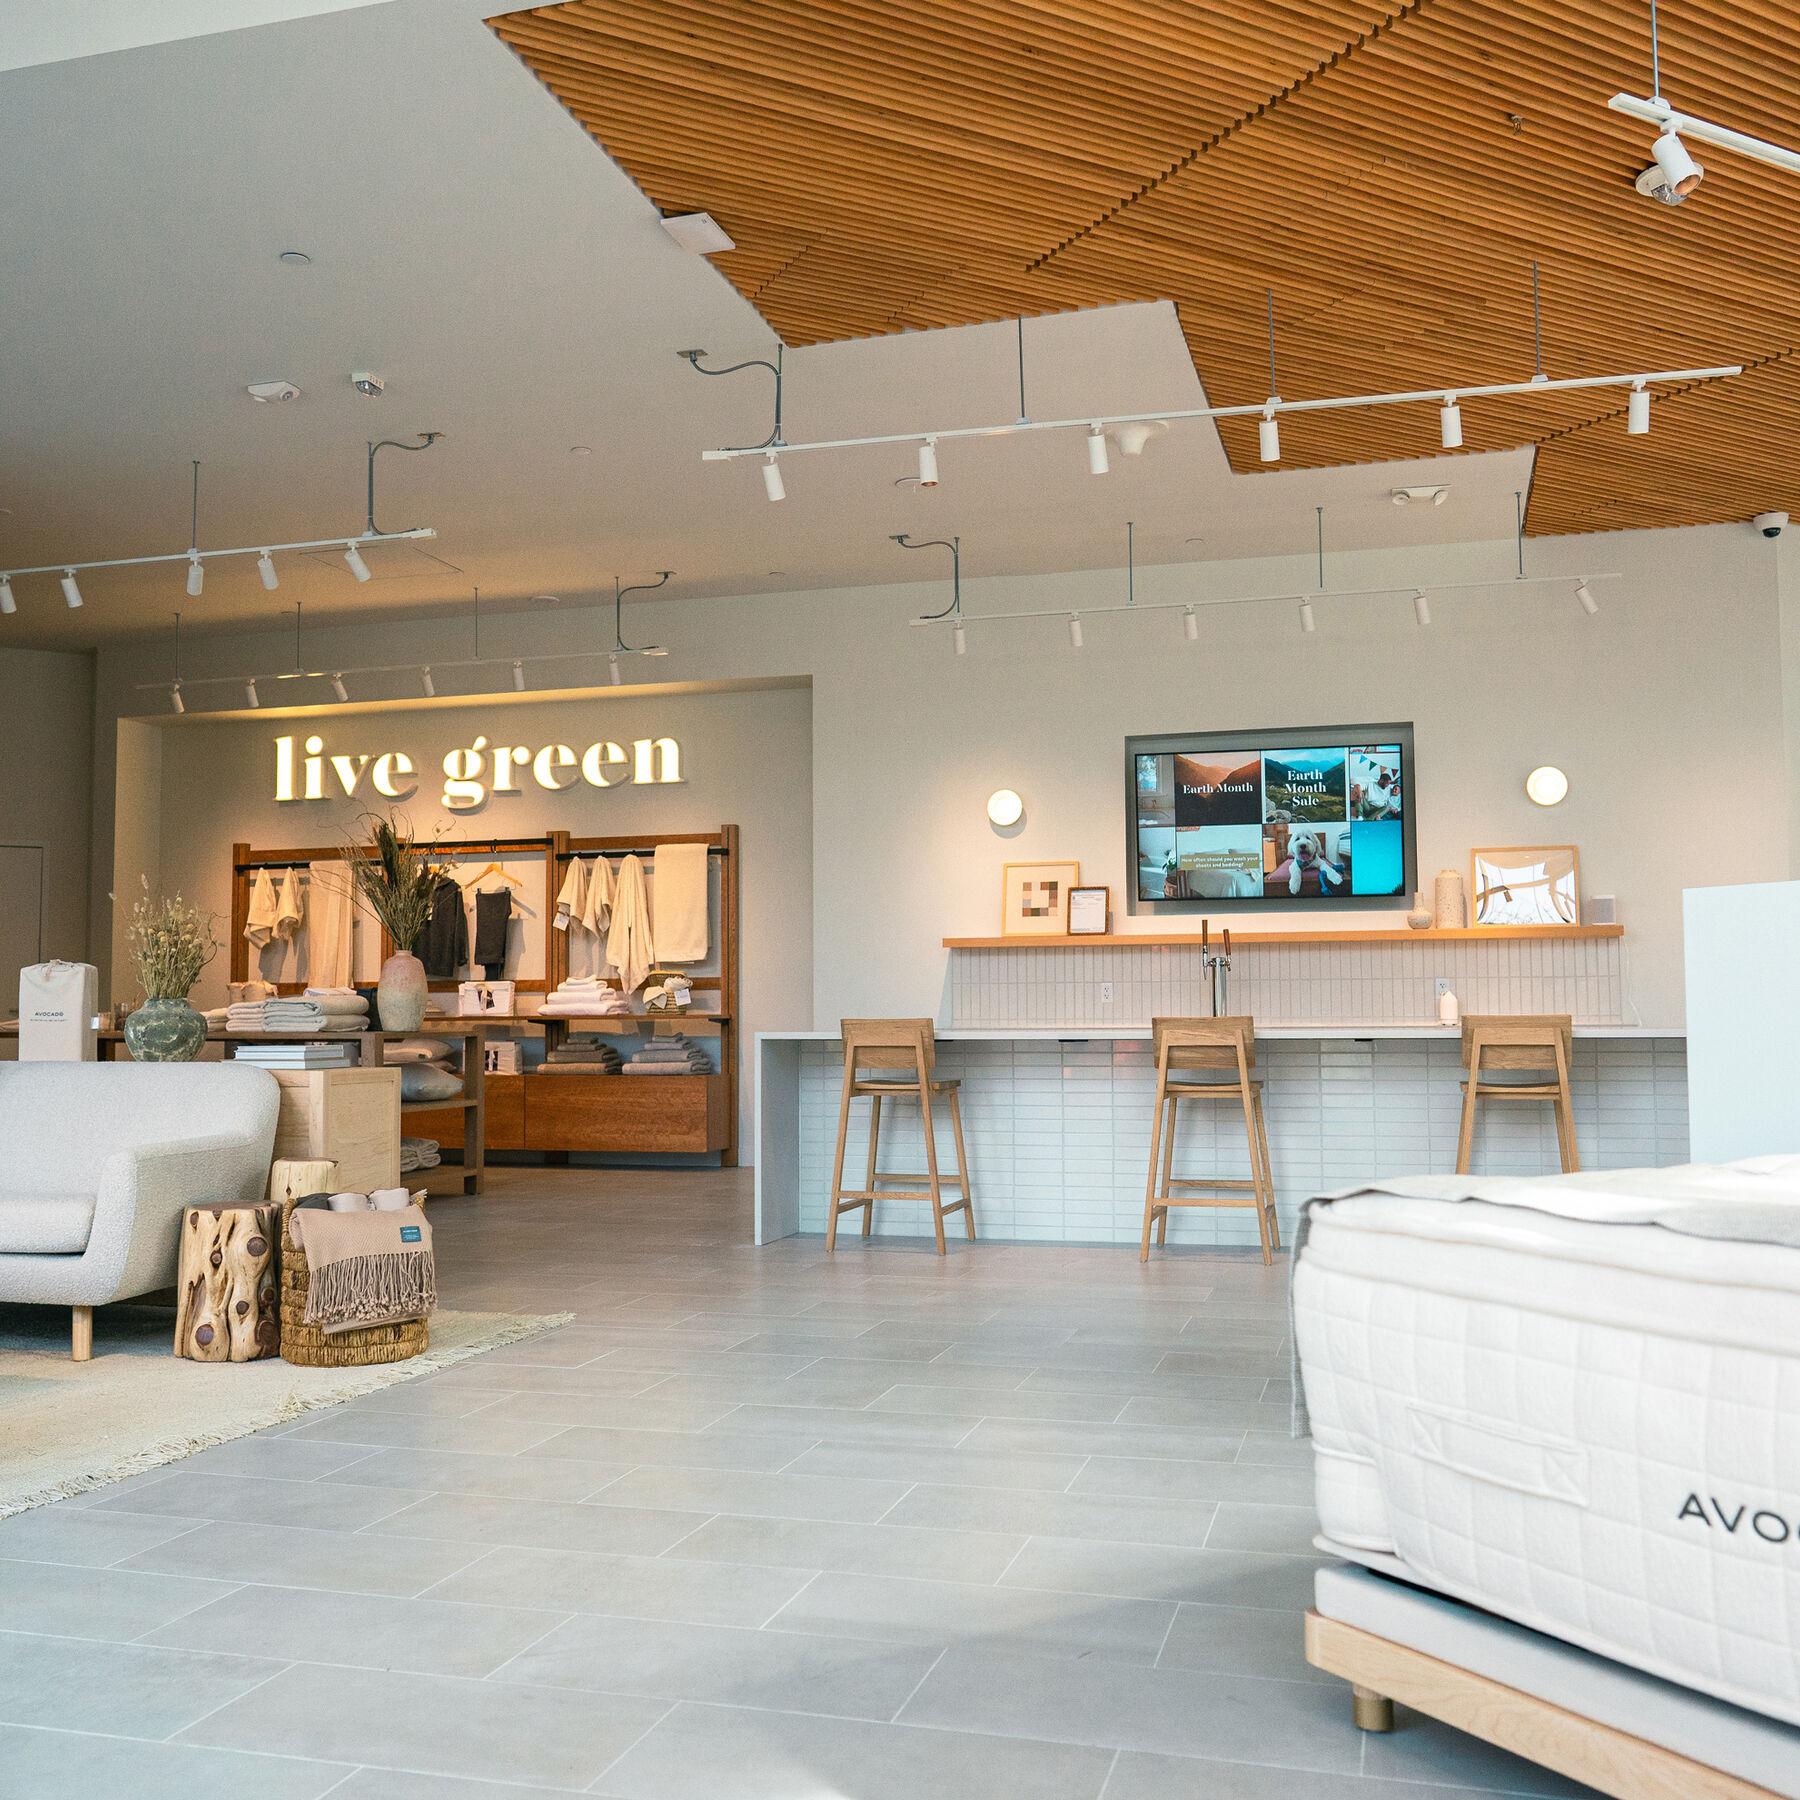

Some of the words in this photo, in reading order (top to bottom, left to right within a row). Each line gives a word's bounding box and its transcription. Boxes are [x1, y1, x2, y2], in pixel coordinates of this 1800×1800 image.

[274, 735, 417, 801] live
[441, 735, 685, 810] green
[1287, 769, 1323, 781] Earth
[1183, 784, 1214, 794] Earth
[1216, 782, 1254, 793] Month
[1284, 782, 1327, 794] Month
[1292, 795, 1320, 807] Sale
[1678, 1493, 1800, 1543] AVO
